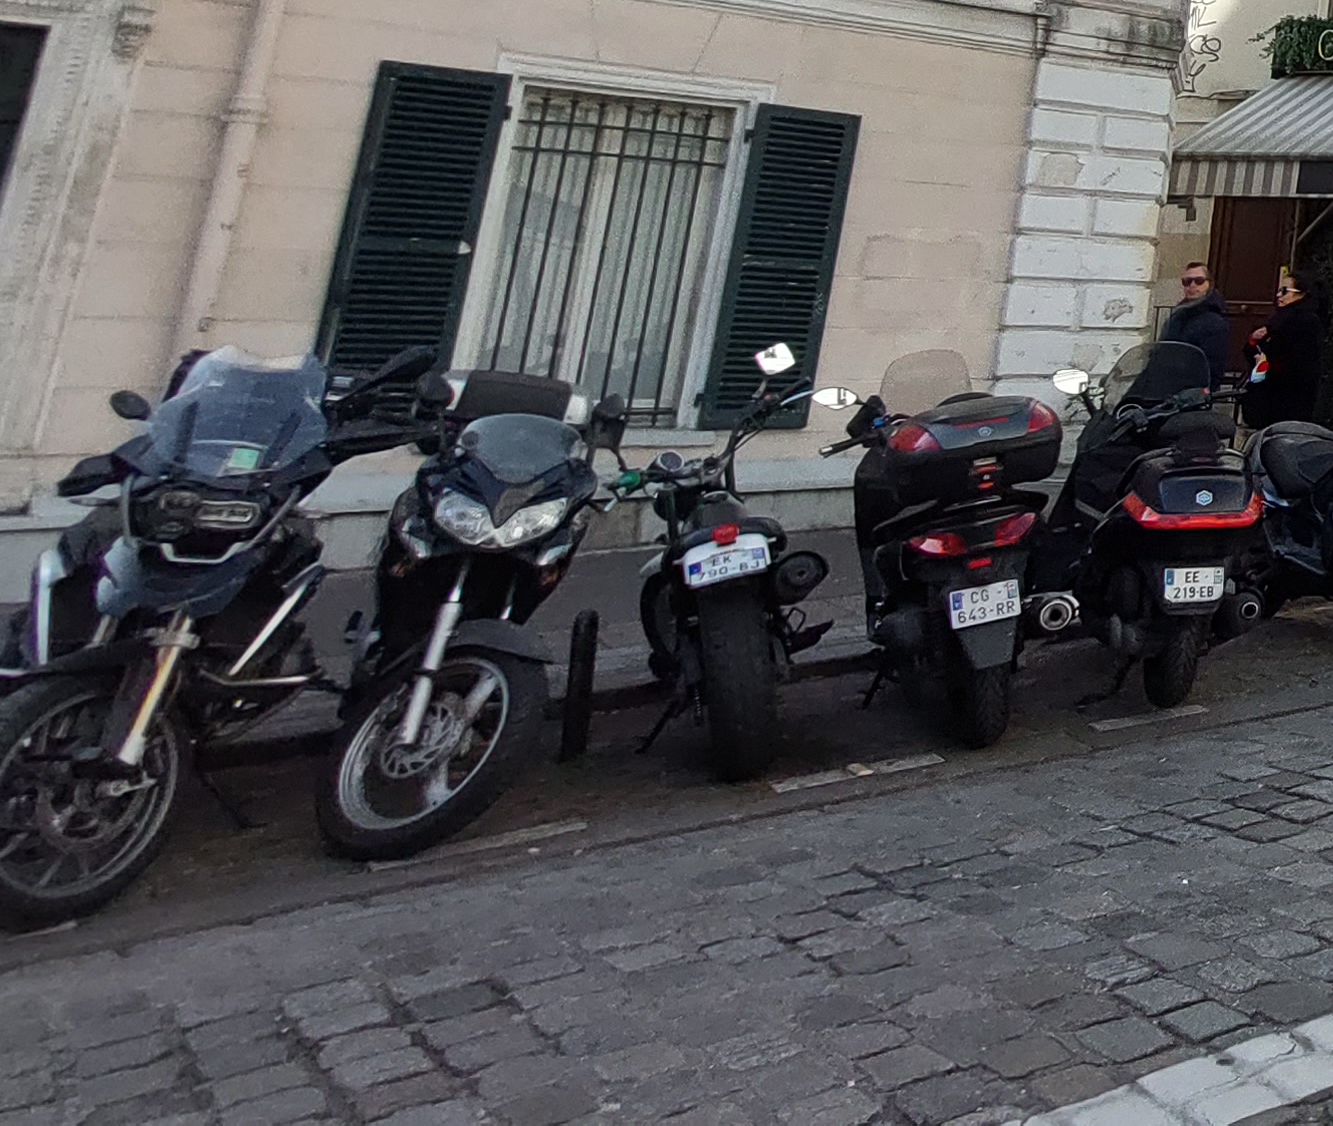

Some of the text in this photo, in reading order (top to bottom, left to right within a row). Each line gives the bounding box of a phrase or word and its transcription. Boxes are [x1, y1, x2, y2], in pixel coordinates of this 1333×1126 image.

[1184, 570, 1200, 584] EE
[970, 588, 990, 604] CG
[957, 600, 1015, 624] 643-RR
